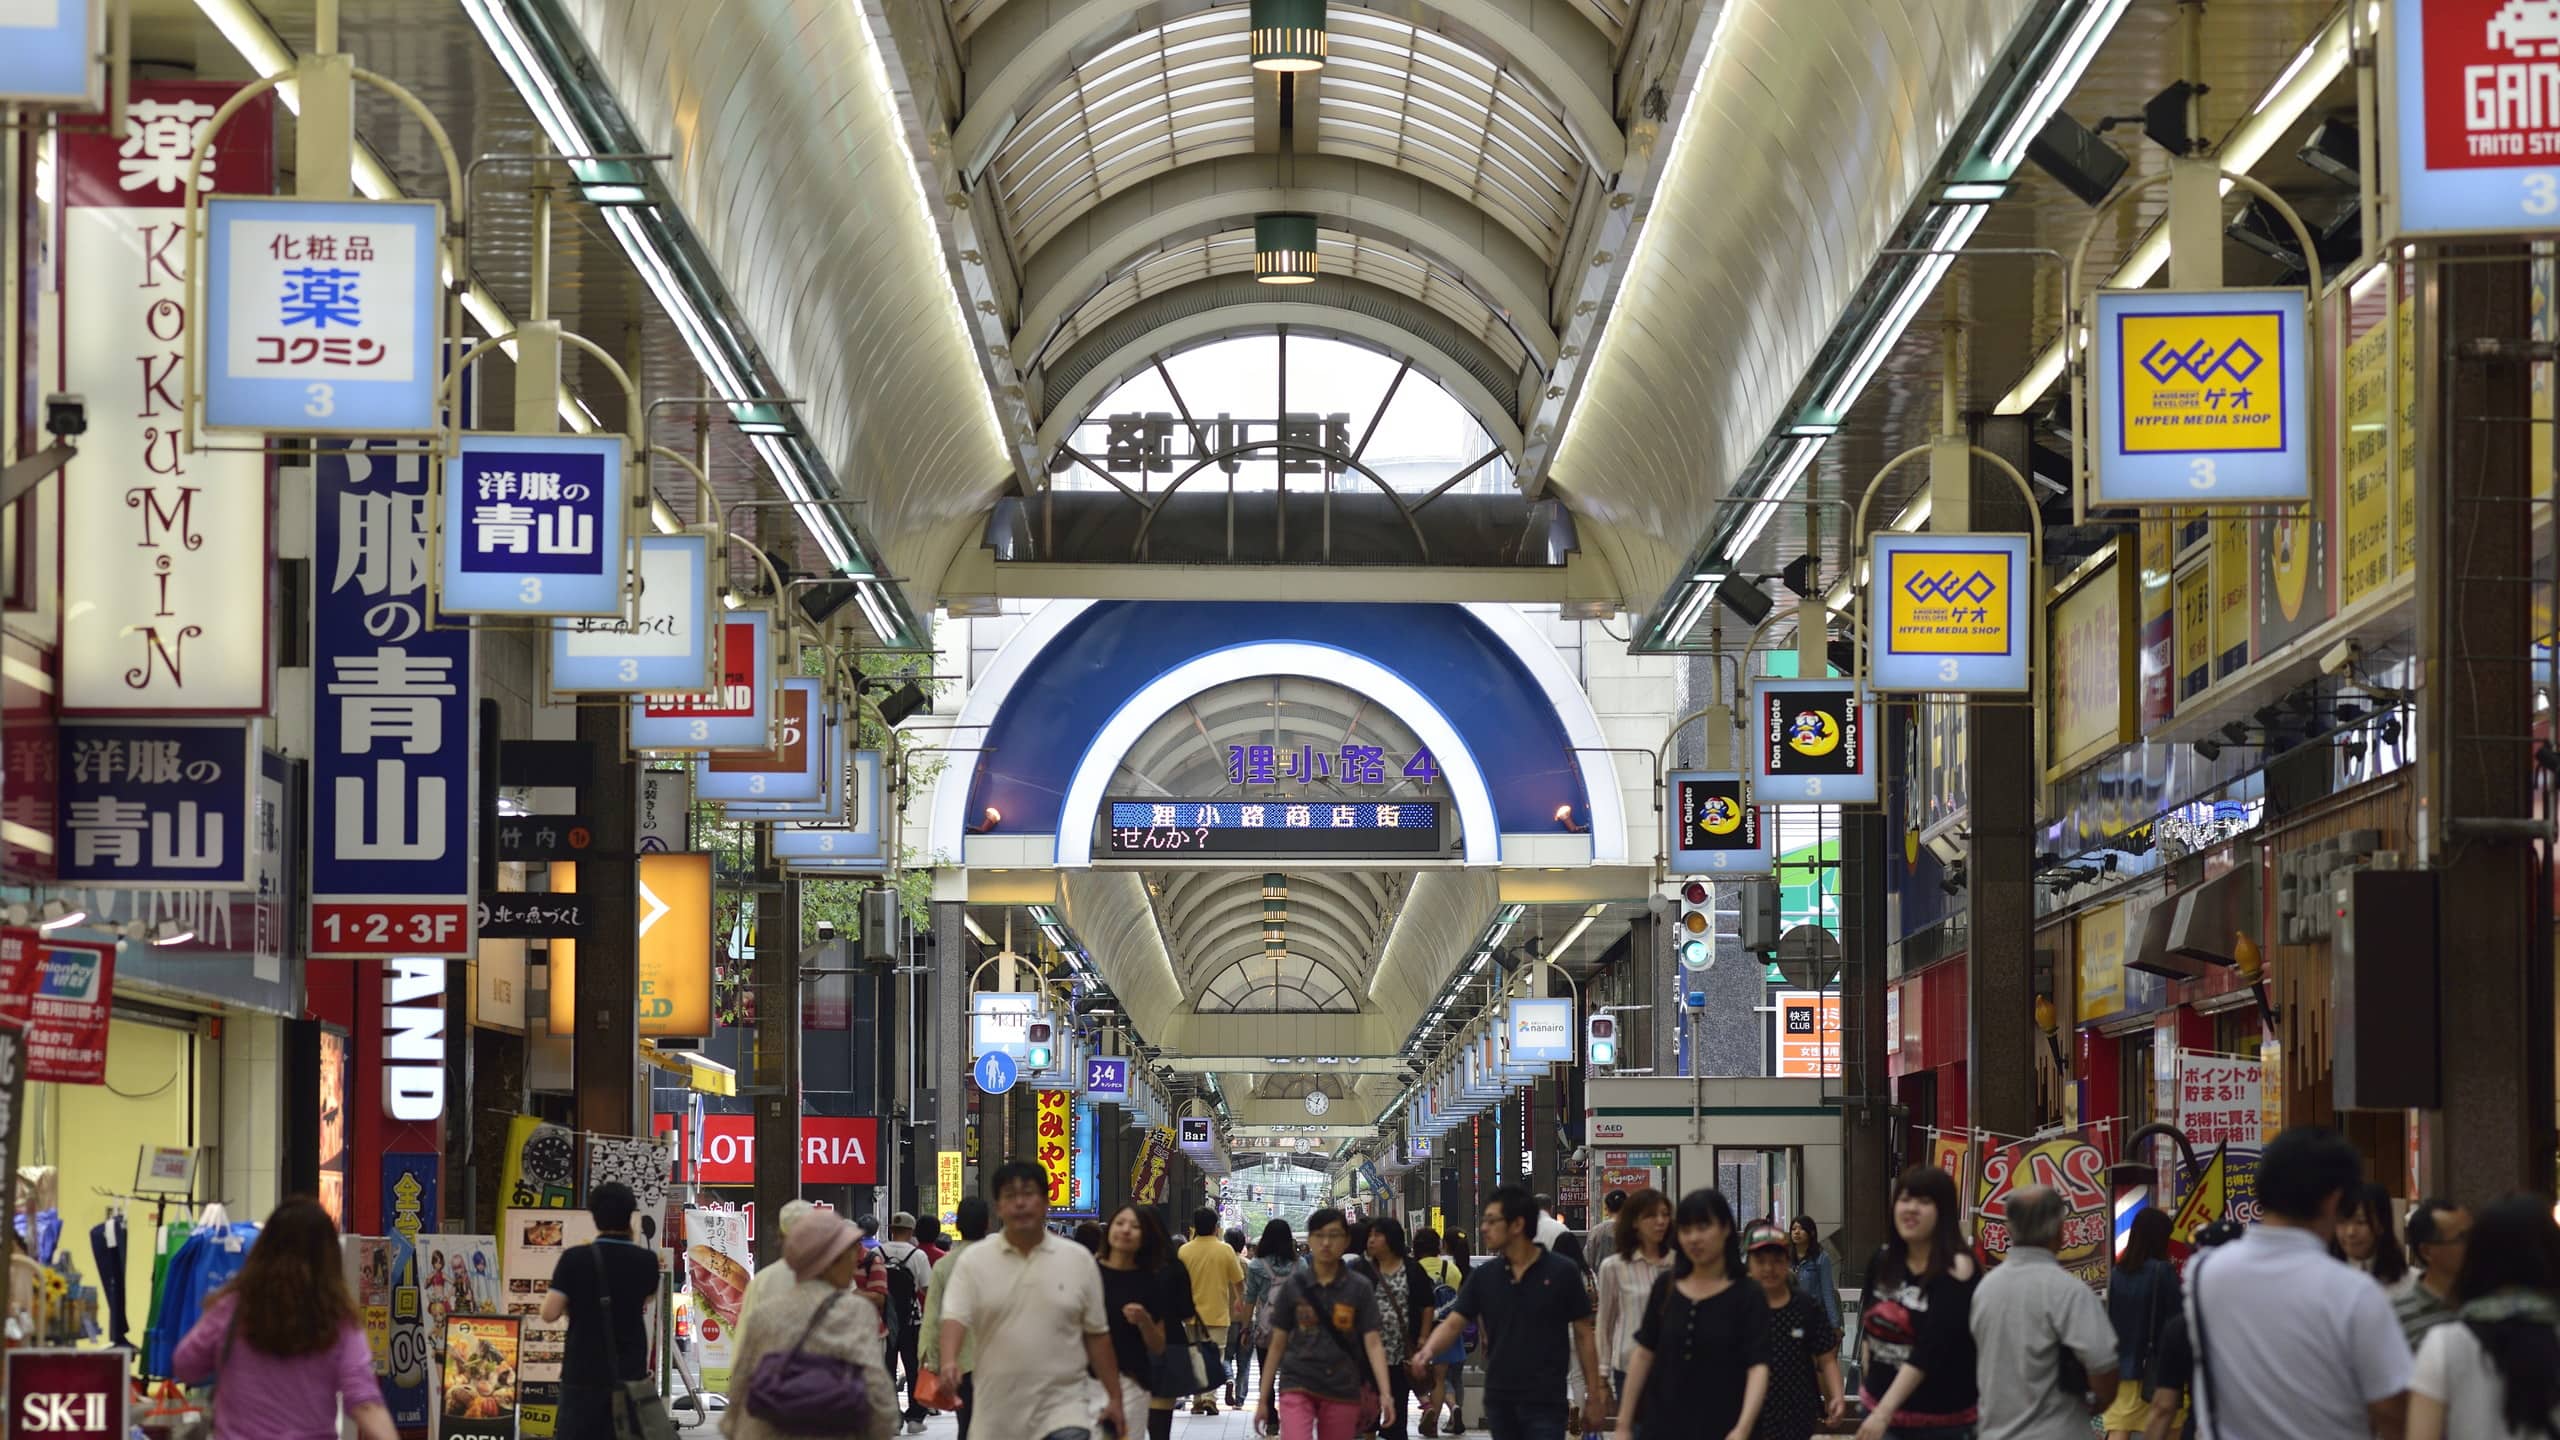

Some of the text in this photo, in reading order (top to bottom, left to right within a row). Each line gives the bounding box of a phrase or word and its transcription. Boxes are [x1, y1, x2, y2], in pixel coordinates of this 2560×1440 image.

[119, 99, 216, 192] 薬
[2466, 133, 2524, 156] TAITO
[2522, 172, 2558, 216] 3
[269, 233, 375, 262] 化粧品
[280, 267, 361, 329] 薬
[256, 336, 386, 366] コクミン
[2140, 337, 2264, 384] GEO
[304, 383, 335, 417] 3
[2204, 387, 2253, 410] ゲオ
[2134, 414, 2271, 426] HYPER MEDIA SHOP
[477, 471, 590, 502] 洋服の
[2189, 458, 2217, 489] 3
[472, 502, 594, 555] 青山
[519, 577, 543, 604] 3
[1904, 569, 1996, 603] GEO
[1951, 607, 1987, 623] ゲオ
[1899, 626, 2001, 635] HYPER MEDIA SHOP
[618, 658, 638, 683] 3
[1939, 658, 1959, 682] 3
[690, 720, 709, 740] 3
[1770, 699, 1783, 768] Don Quijote
[1845, 724, 1856, 768] Quijote
[73, 740, 222, 785] 洋服の
[1228, 744, 1439, 785] 狸小路 4
[748, 774, 766, 793] 3
[1806, 778, 1822, 796] 3
[1151, 804, 1401, 828] 狸小路商店街
[1684, 787, 1693, 845] Don Quijote
[66, 796, 224, 868] 青山
[820, 836, 833, 851] 3
[1713, 852, 1727, 868] 3
[1530, 1023, 1564, 1032] nanairo
[1789, 1010, 1811, 1022] 快活
[1790, 1021, 1811, 1030] CLUB
[1184, 1131, 1206, 1141] Bar
[1604, 1124, 1623, 1132] AED
[22, 1392, 108, 1432] SK-II
